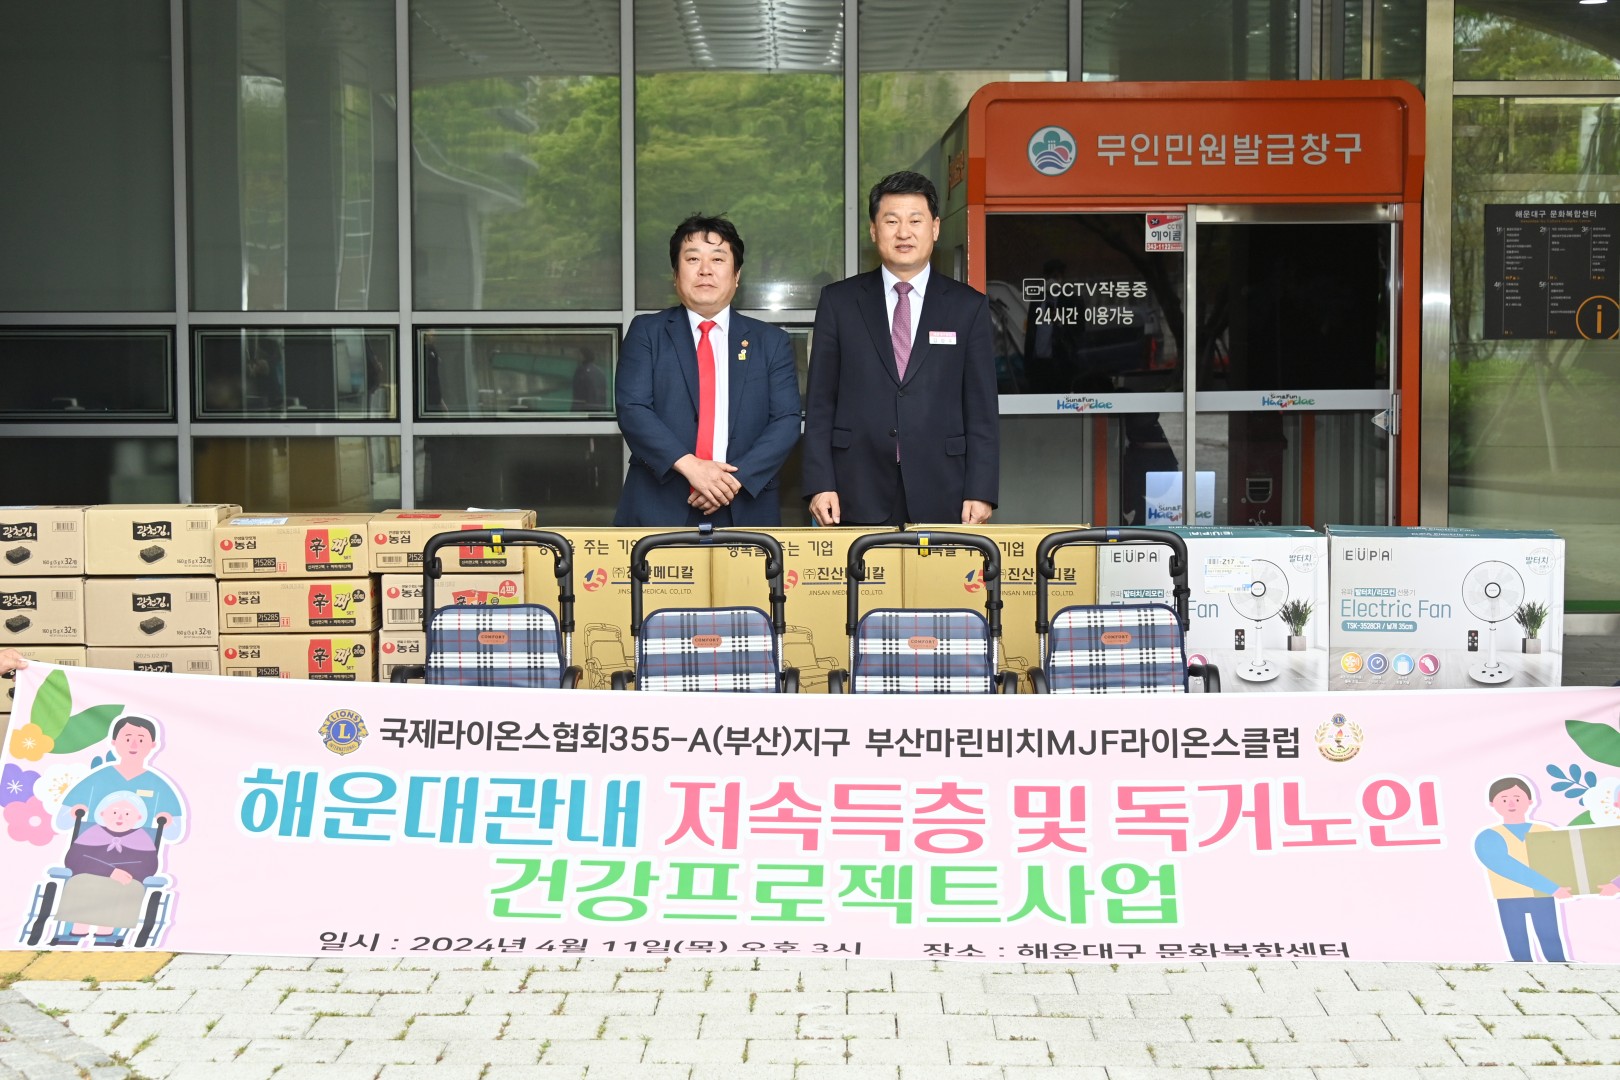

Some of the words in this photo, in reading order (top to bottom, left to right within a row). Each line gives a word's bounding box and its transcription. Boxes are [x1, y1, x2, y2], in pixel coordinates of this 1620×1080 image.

[1097, 133, 1363, 166] 무인민원발급창구
[1515, 210, 1547, 219] 해운대구
[1550, 210, 1597, 219] 문화복합센터
[1049, 281, 1148, 298] CCTV작동중
[1035, 306, 1079, 325] 24시간
[1084, 306, 1134, 325] 이용가능
[3, 526, 33, 538] 광천김
[137, 525, 167, 537] 광천김
[235, 541, 256, 550] 농심
[389, 535, 410, 544] 농심
[309, 537, 327, 559] 辛
[584, 540, 609, 555] 주는
[808, 541, 833, 557] 기업
[1289, 554, 1312, 563] 발터치
[1525, 556, 1549, 565] 발터치
[1124, 590, 1164, 598] 발터치/리모컨
[1355, 588, 1396, 596] 발터치/리모컨
[3, 595, 32, 606] 광천김
[137, 596, 166, 608] 광천김
[238, 596, 260, 604] 농심
[313, 592, 330, 614] 辛
[1341, 599, 1412, 618] Electric
[1419, 600, 1452, 618] Fan
[258, 614, 279, 622] 가5285
[238, 650, 260, 658] 농심
[396, 644, 420, 654] 농심
[313, 647, 330, 669] 辛
[258, 668, 279, 676] 가5285
[330, 710, 360, 722] LIONS
[338, 724, 350, 738] L
[379, 717, 850, 758] 국제라이온스협회355-A(부산)지구
[865, 727, 1299, 759] 부산마린비치MJF라이온스클럽
[240, 768, 640, 848] 해운대관내
[664, 781, 987, 855] 저속득층
[1013, 785, 1088, 854] 및
[1115, 779, 1442, 853] 독거노인
[489, 858, 1180, 926] 건강프로젝트사업
[319, 931, 380, 952] 일시
[410, 937, 526, 954] 2024년
[535, 938, 588, 954] 4월
[1017, 943, 1147, 959] 해운대구
